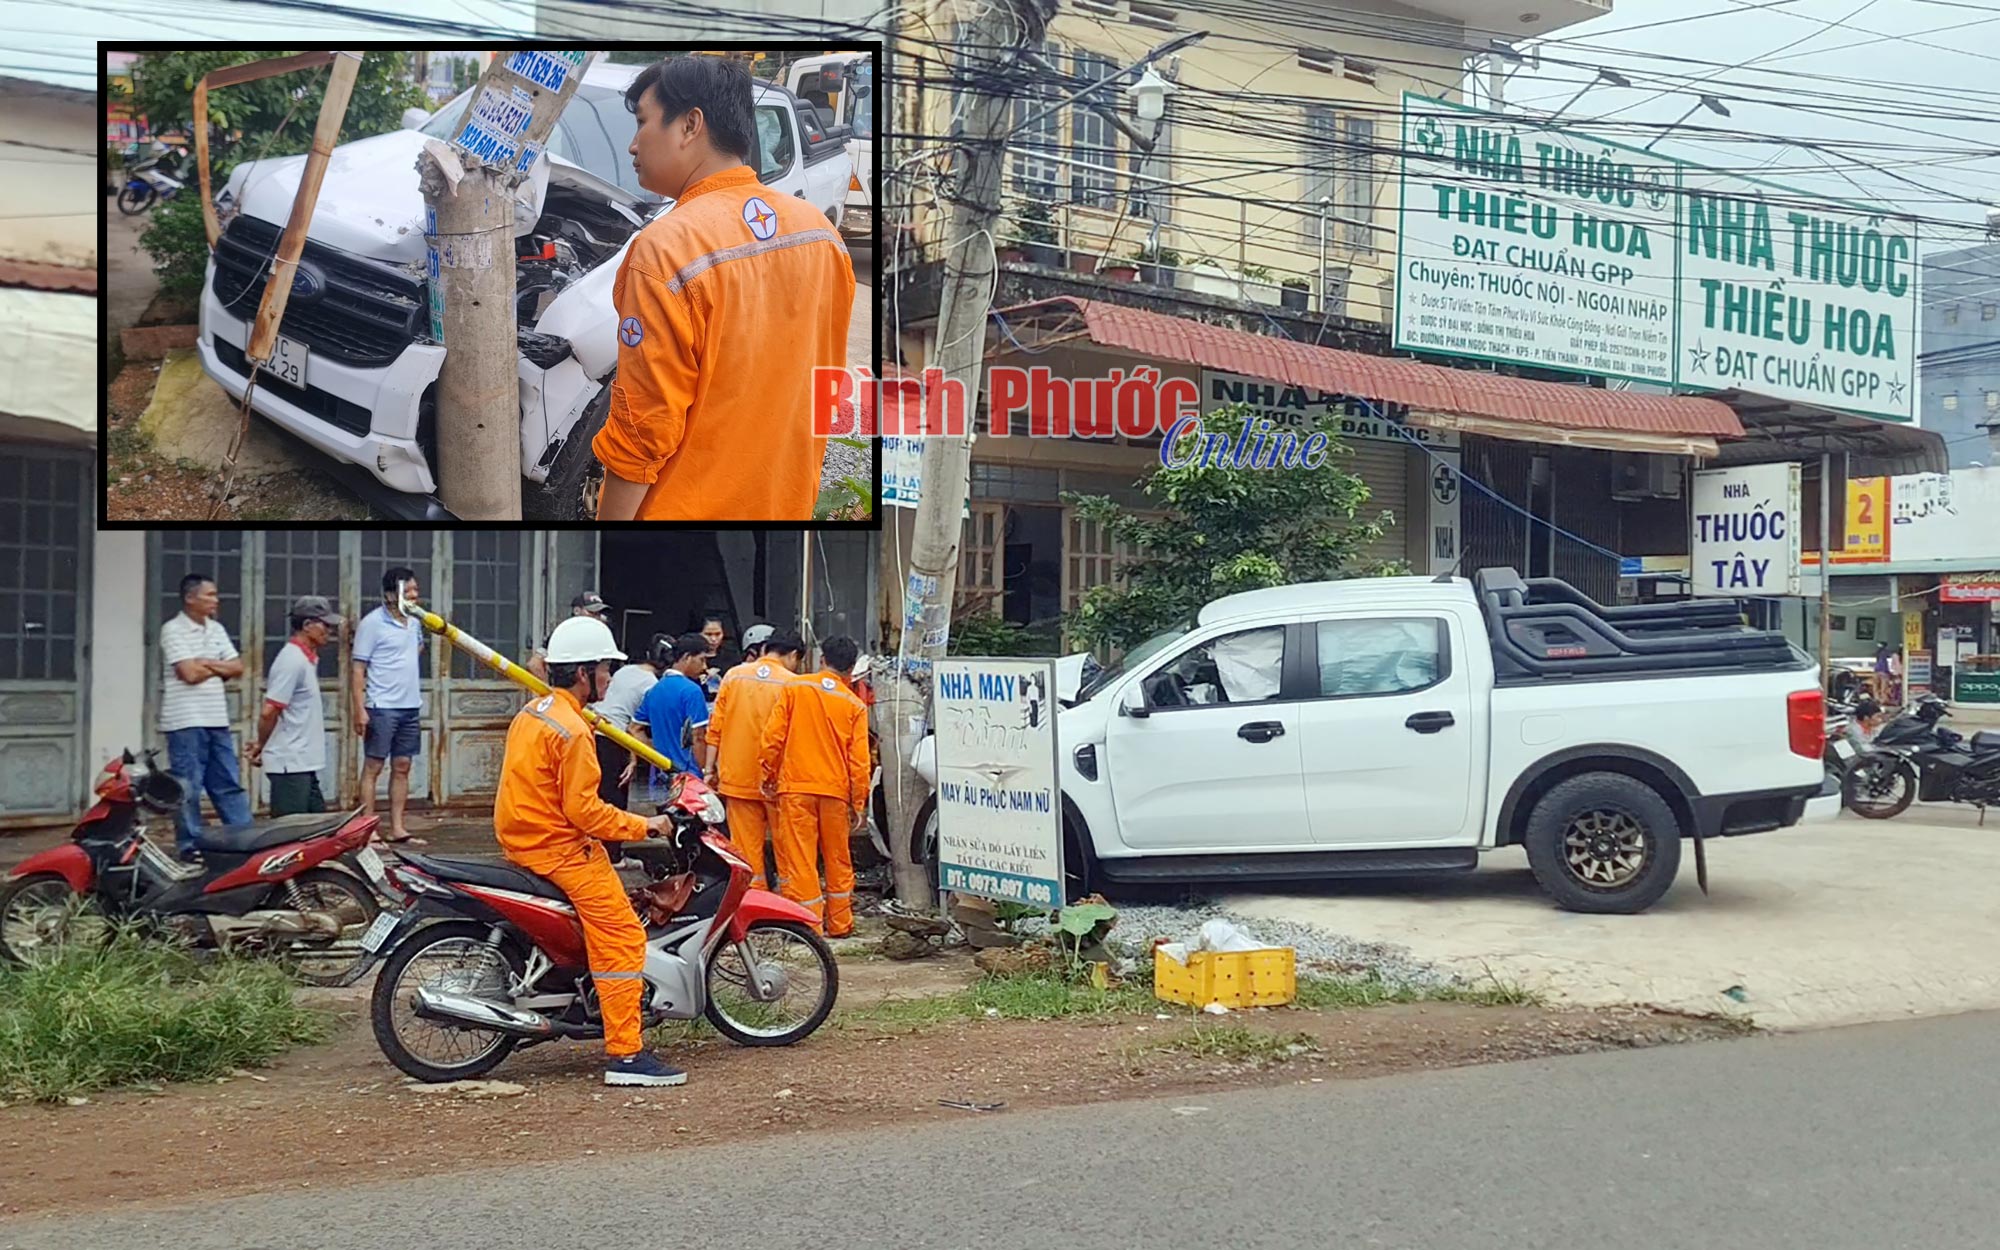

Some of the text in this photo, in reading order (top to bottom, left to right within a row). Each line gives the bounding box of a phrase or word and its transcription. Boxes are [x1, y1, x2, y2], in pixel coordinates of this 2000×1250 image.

[1454, 124, 1636, 209] NHÀ THUỐC
[1572, 211, 1652, 260] HOA
[1688, 188, 1909, 298] NHÀ THUỐC
[1452, 234, 1634, 287] ĐẠT CHUẨN GPP
[1409, 260, 1475, 290] Chuyên:
[1478, 271, 1534, 300] THUỐC
[1537, 281, 1565, 309] NỘI
[1577, 289, 1625, 320] NGOẠI
[1627, 298, 1668, 326] NHẬP
[1700, 277, 1896, 361] THIỀU HOA
[1715, 346, 1881, 400] ĐẠT CHUẨN GPP
[1723, 480, 1751, 498] NHÀ
[1858, 493, 1873, 525] 2
[1696, 498, 1785, 543] THUỐC
[1711, 551, 1771, 589] TÂY
[940, 666, 1015, 701] NHÀ MAY
[941, 781, 960, 803] MAY
[964, 780, 977, 805] ÂU
[980, 790, 1006, 815] PHỤC
[1009, 790, 1033, 812] NAM
